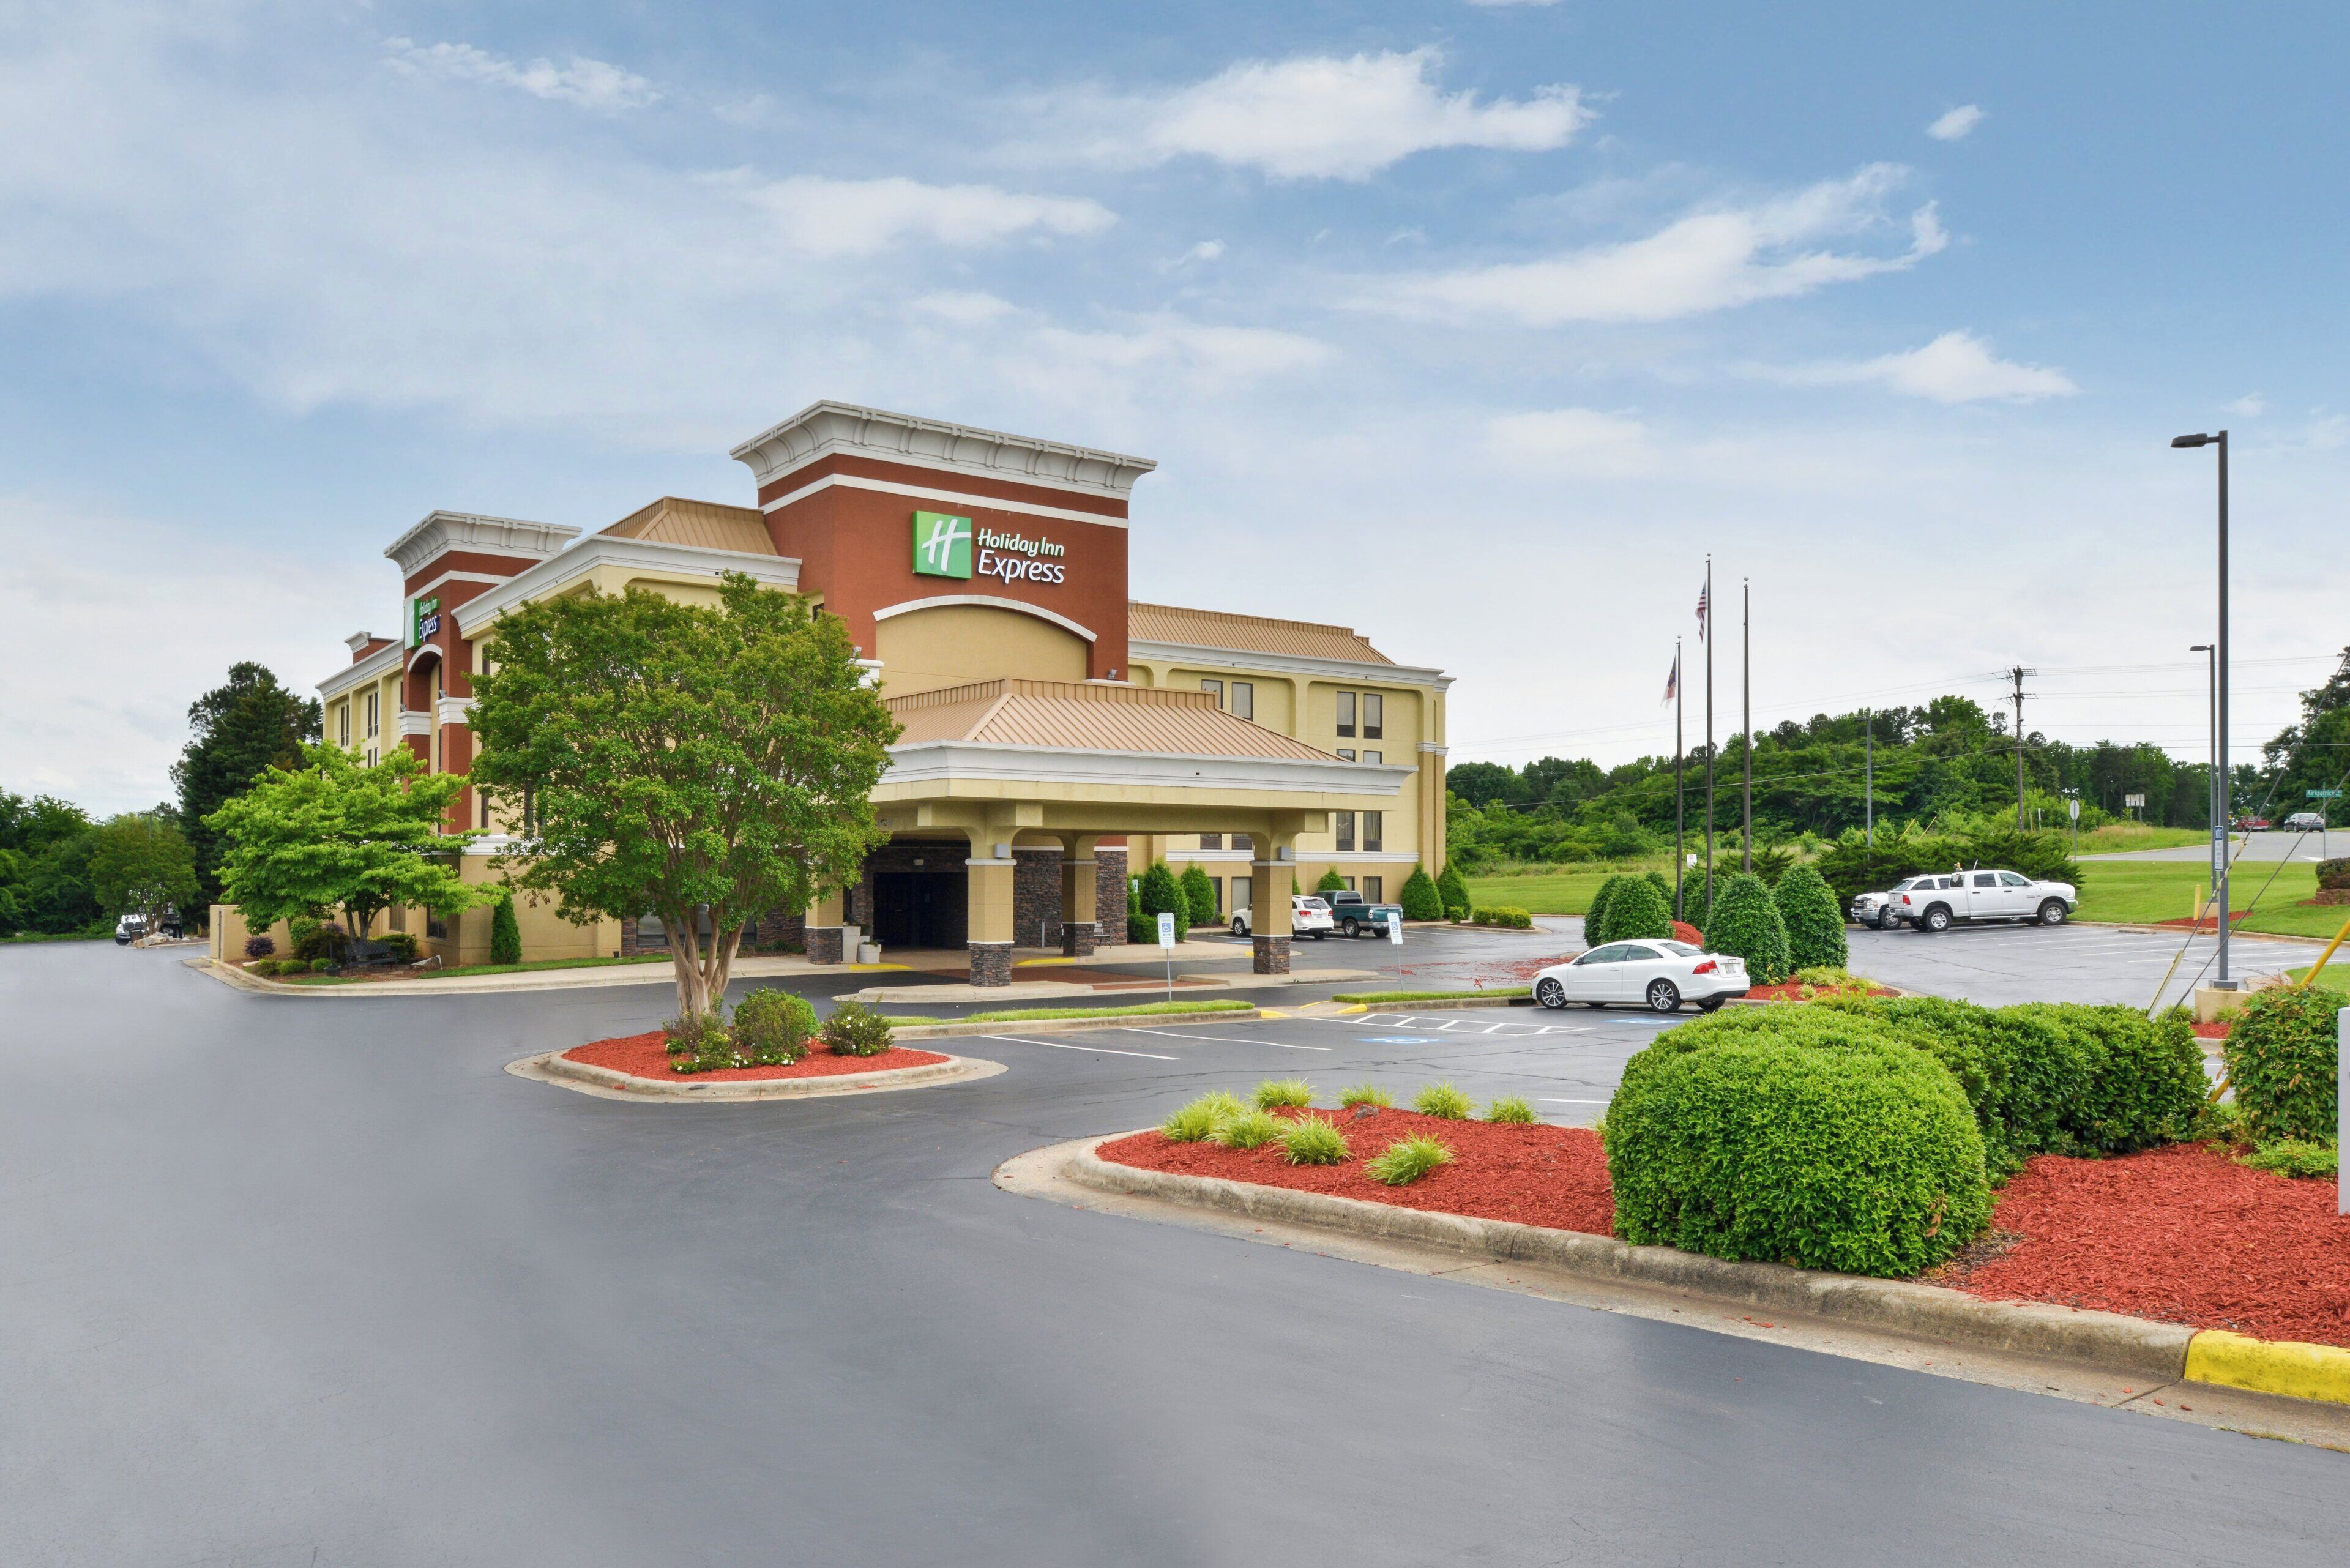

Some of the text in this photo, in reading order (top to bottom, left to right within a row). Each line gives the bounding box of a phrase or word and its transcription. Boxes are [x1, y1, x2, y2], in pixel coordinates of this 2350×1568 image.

[977, 528, 1065, 558] Holiday Inn
[978, 549, 1065, 584] Express
[419, 599, 431, 617] Holiday
[419, 615, 437, 643] Express
